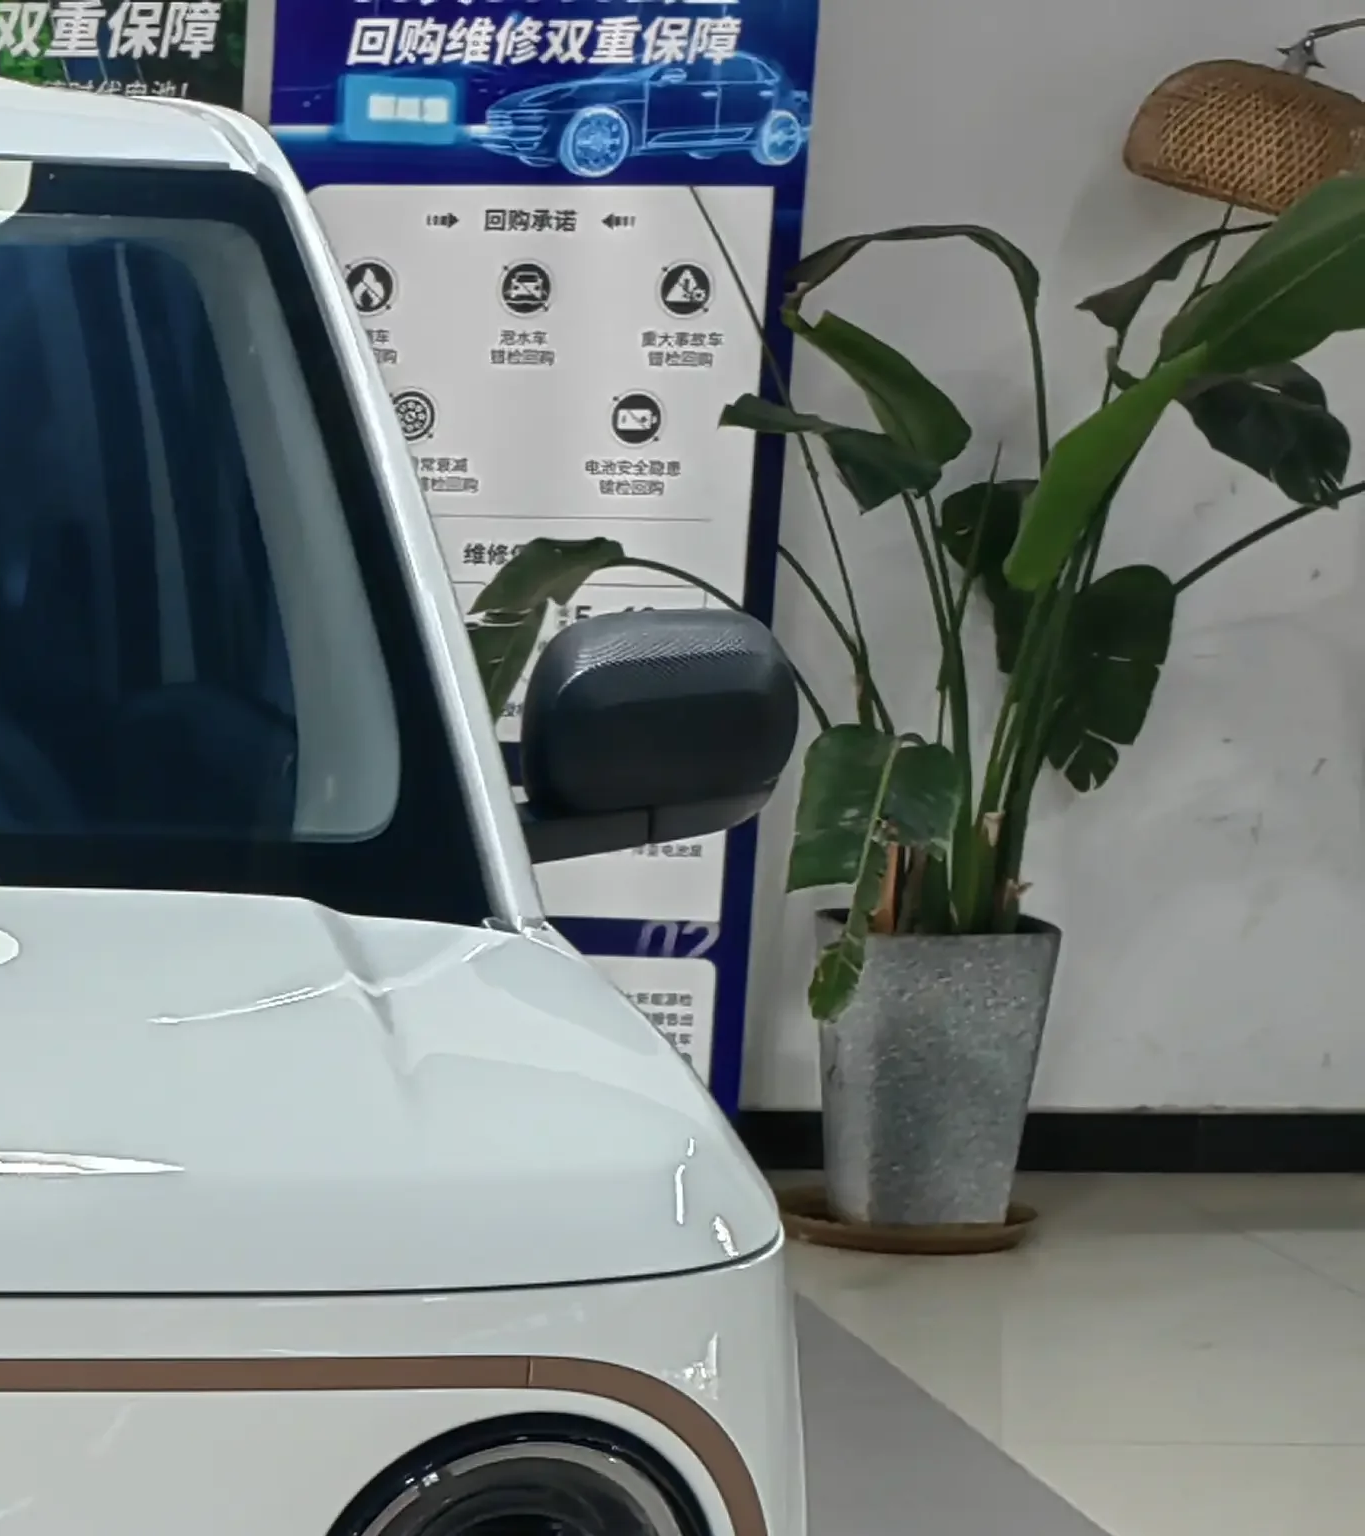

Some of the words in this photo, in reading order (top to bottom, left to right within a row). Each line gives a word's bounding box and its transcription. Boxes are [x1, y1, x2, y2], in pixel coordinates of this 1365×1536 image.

[346, 16, 742, 65] 回购维修双重保障
[483, 209, 578, 232] 回购承诺
[641, 331, 723, 347] 重大事故车
